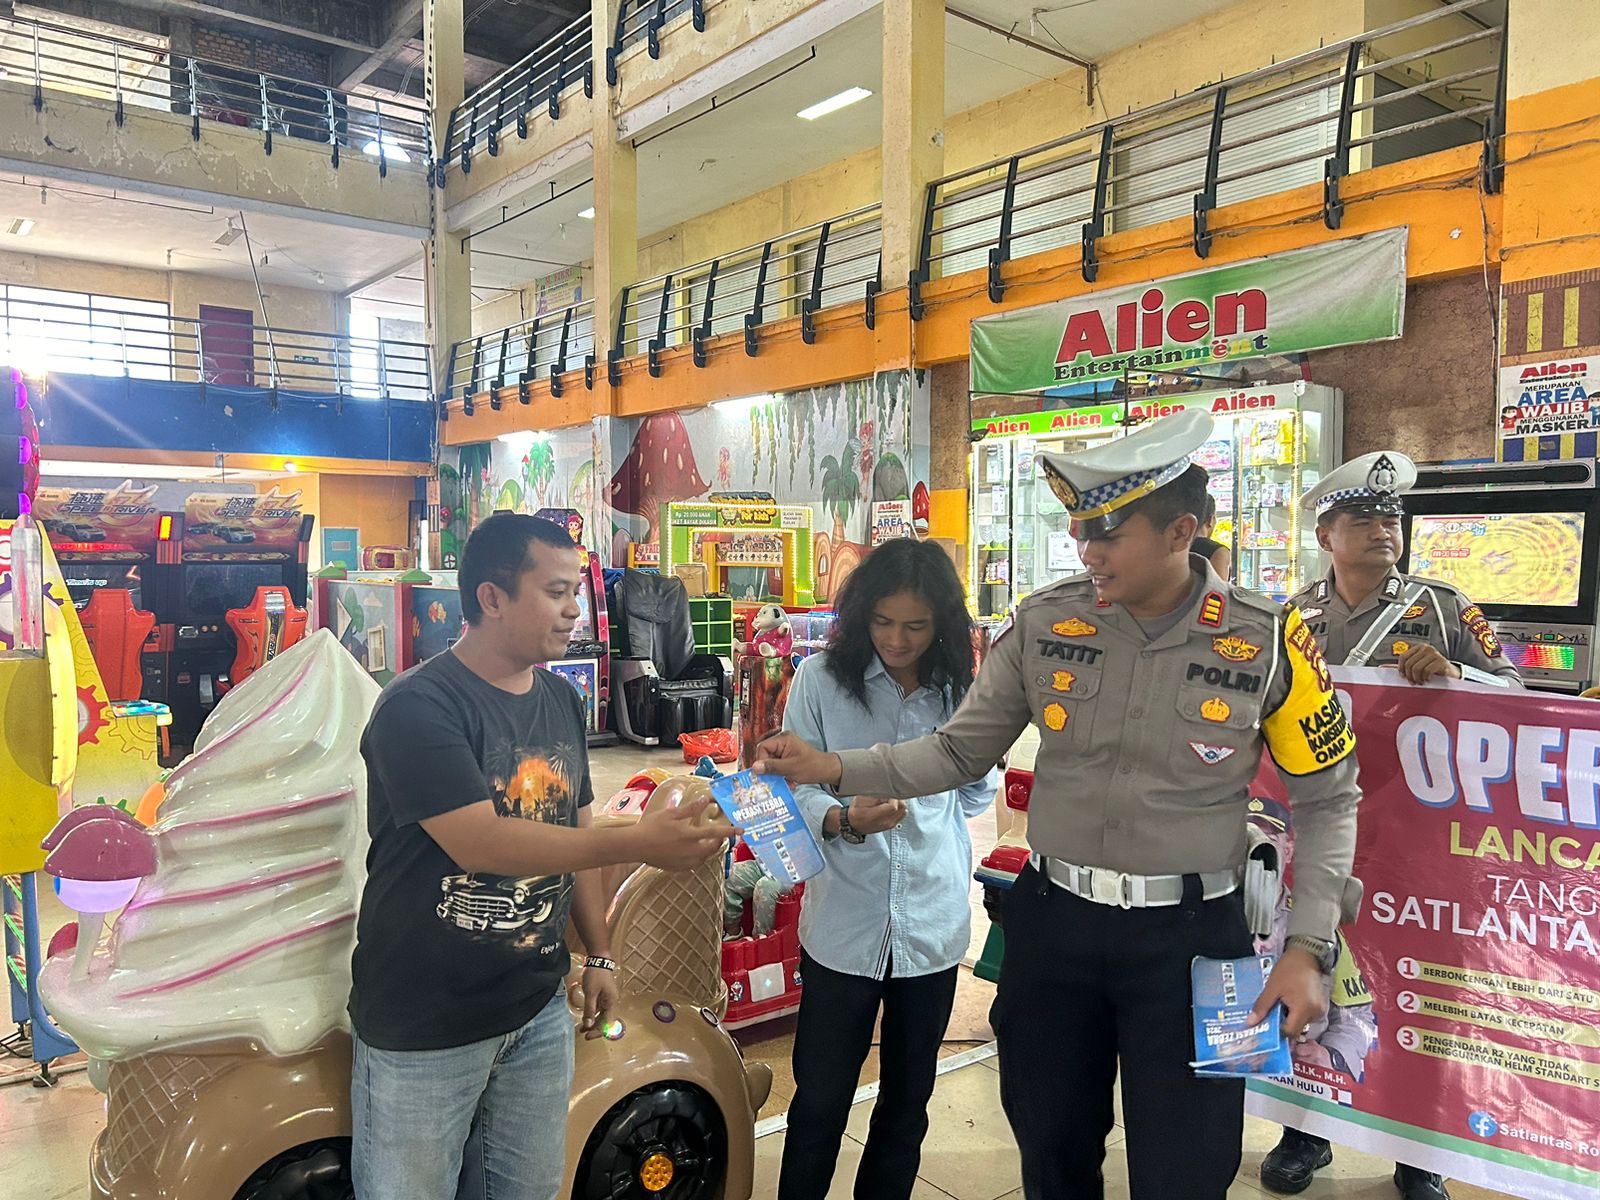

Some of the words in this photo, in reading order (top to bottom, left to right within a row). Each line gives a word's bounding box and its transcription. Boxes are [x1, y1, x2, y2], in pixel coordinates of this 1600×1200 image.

[1055, 288, 1267, 363] Alien
[1520, 363, 1587, 378] Alien
[1517, 386, 1588, 406] AREA
[1525, 381, 1581, 392] MERUPAKAN
[1212, 392, 1275, 412] Alien
[1521, 401, 1585, 418] WAJIB
[986, 419, 1029, 433] Alien
[1051, 412, 1101, 428] Alien
[1516, 419, 1589, 435] MASKER
[1520, 414, 1585, 424] MENGGUNAKAN
[877, 518, 903, 526] AREA
[879, 526, 902, 534] WAJIB
[1388, 622, 1430, 637] OLRI
[1037, 638, 1103, 665] TATIT
[1187, 662, 1261, 693] POLRI
[1315, 738, 1346, 763] OMP
[732, 806, 763, 821] OPERASI
[763, 796, 785, 811] ZEBRA
[1487, 874, 1598, 916] TANG
[1402, 960, 1415, 977] 1
[1423, 967, 1504, 988] BERBONCENGAN
[1506, 981, 1535, 994] LEBIH
[1538, 987, 1564, 999] DARI
[1566, 991, 1594, 1004] SATU
[1402, 993, 1415, 1010] 2
[1423, 1001, 1468, 1018] MELEBIHI
[1470, 1010, 1503, 1024] BATAS
[1505, 1017, 1564, 1036] KECEPATAN
[1402, 1030, 1414, 1046] 3
[1423, 1035, 1489, 1056] PENGENDARA
[1491, 1047, 1504, 1058] R2
[1506, 1051, 1536, 1065] YANG
[1538, 1058, 1569, 1072] TIDAK
[1423, 1043, 1502, 1066] MENGGUNAKAN
[1504, 1060, 1533, 1073] HELM
[1535, 1063, 1591, 1086] STANDART
[1296, 1080, 1324, 1095] HULU
[1324, 1072, 1347, 1085] M.H.
[1499, 1123, 1573, 1151] Satlantas
[1579, 1141, 1600, 1157] Ro
